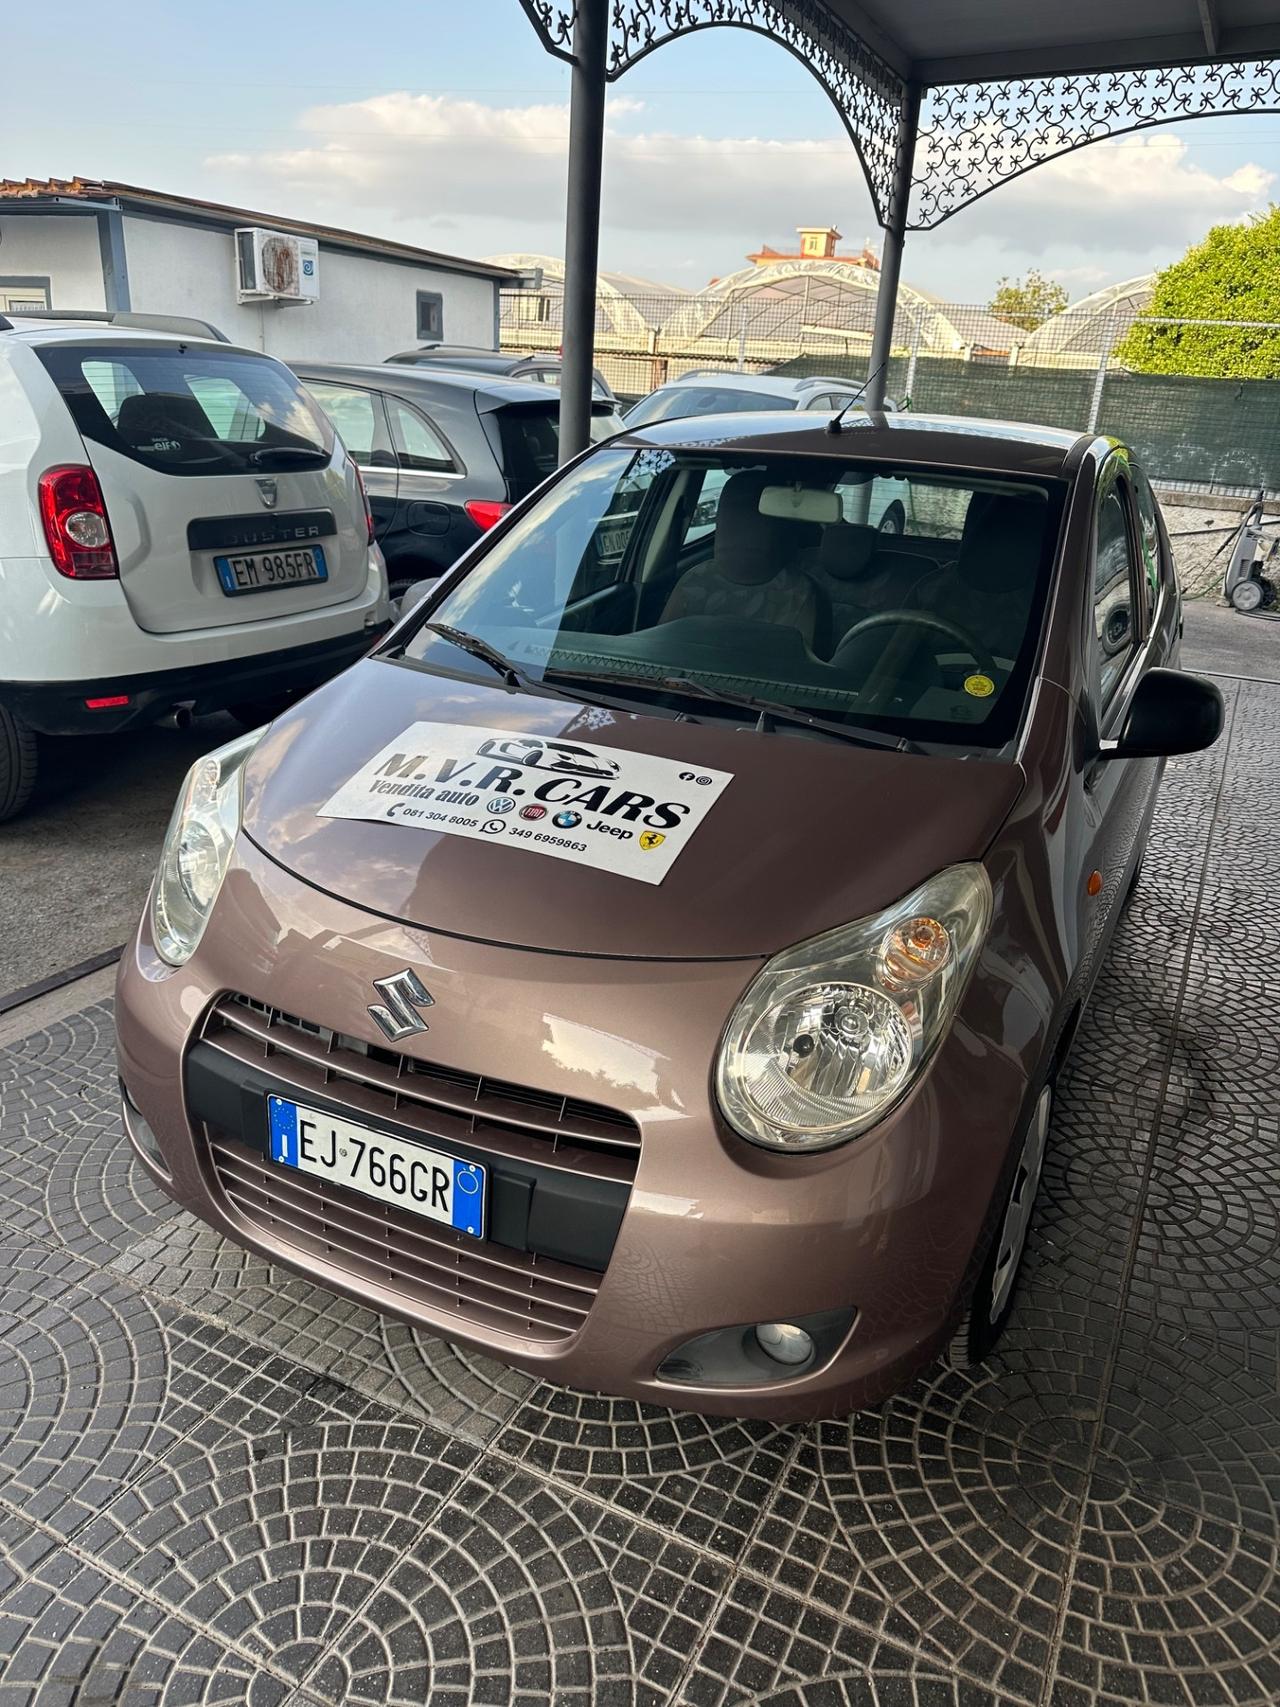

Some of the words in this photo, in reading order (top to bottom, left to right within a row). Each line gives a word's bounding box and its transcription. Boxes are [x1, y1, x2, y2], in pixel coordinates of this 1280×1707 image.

[232, 558, 260, 586] EM
[262, 551, 317, 581] 985FR
[369, 780, 435, 800] Vendita
[435, 790, 480, 807] auto
[403, 807, 425, 818] 081
[426, 811, 448, 822] 304
[449, 815, 479, 828] 8005
[587, 820, 633, 841] Jeep
[509, 827, 533, 839] 349
[534, 832, 588, 852] 6959863
[299, 1119, 337, 1168] EJ
[349, 1137, 450, 1212] 766GR
